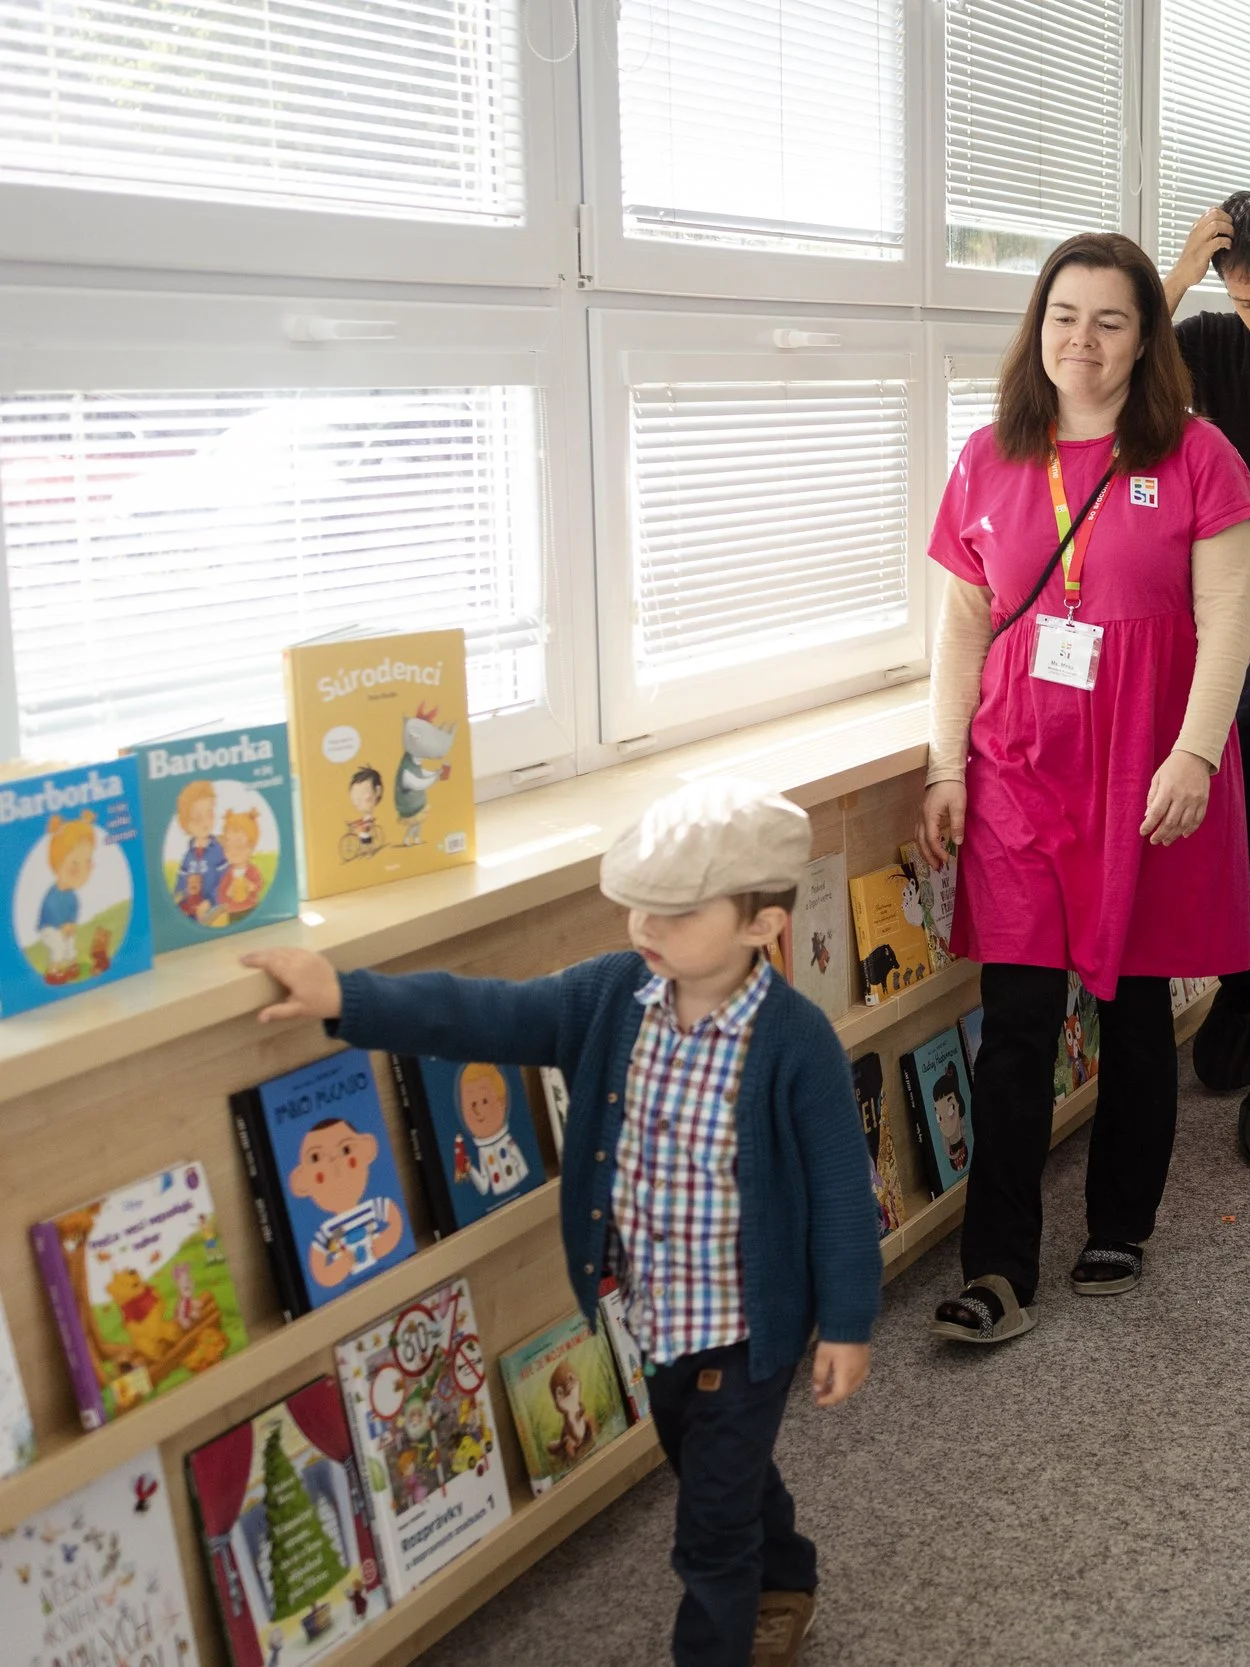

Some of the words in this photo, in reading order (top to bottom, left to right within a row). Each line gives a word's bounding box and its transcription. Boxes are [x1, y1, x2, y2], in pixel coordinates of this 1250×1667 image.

[317, 656, 444, 703] Súrodenci
[147, 735, 273, 780] Barborka
[0, 771, 123, 824] Barborka
[487, 1493, 495, 1510] 1
